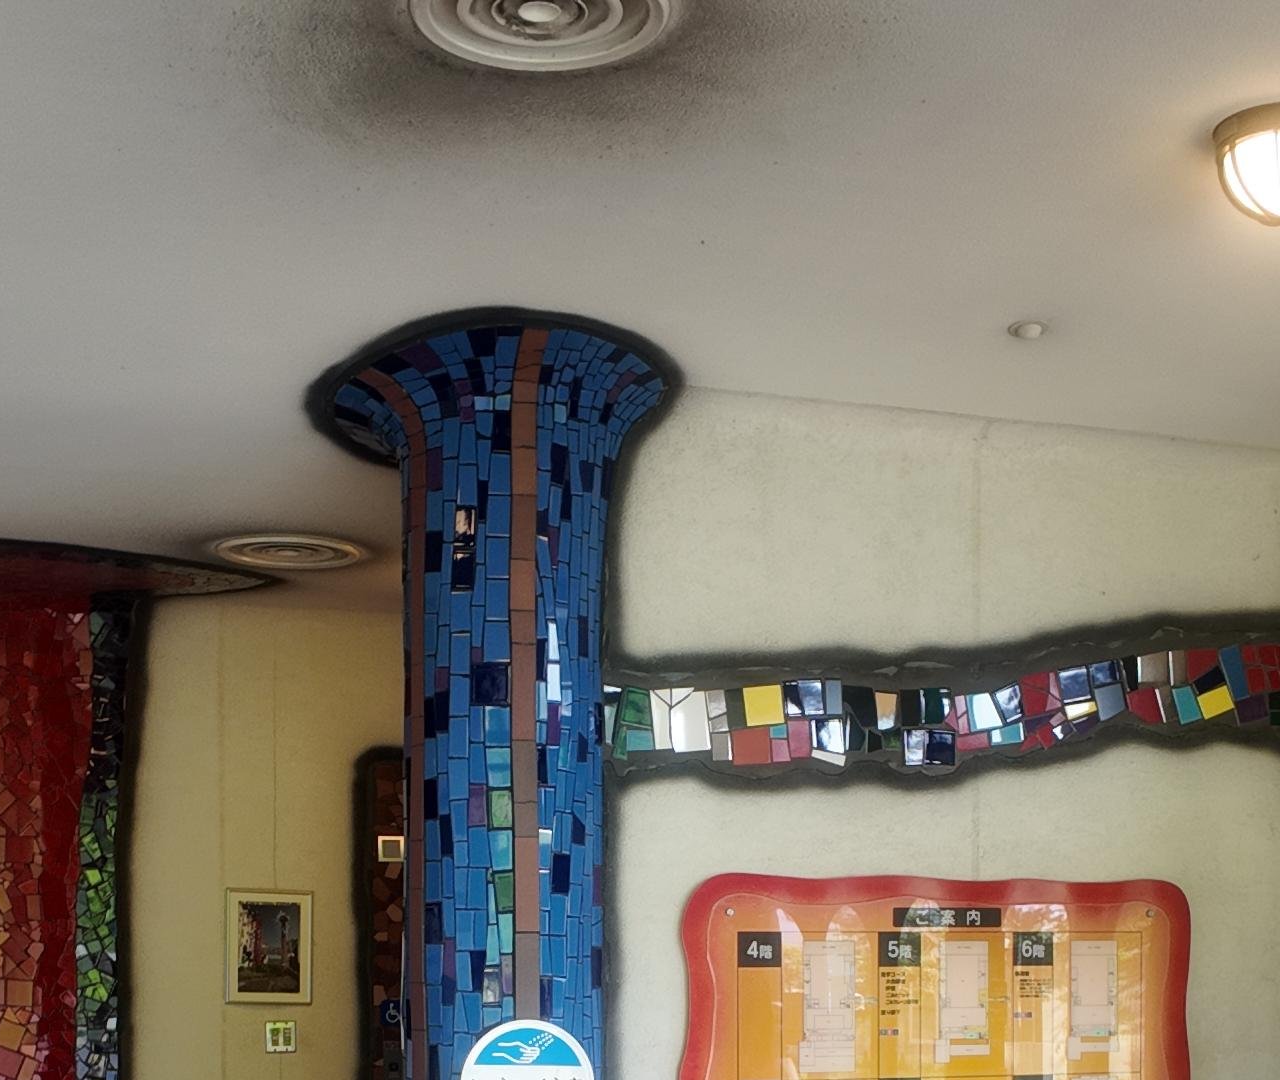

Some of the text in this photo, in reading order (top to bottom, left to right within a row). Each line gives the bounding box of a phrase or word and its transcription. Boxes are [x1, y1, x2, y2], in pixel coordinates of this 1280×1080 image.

[915, 909, 982, 926] ご案内
[746, 940, 773, 960] 4階
[887, 940, 913, 960] 5階
[1021, 940, 1046, 958] 6階
